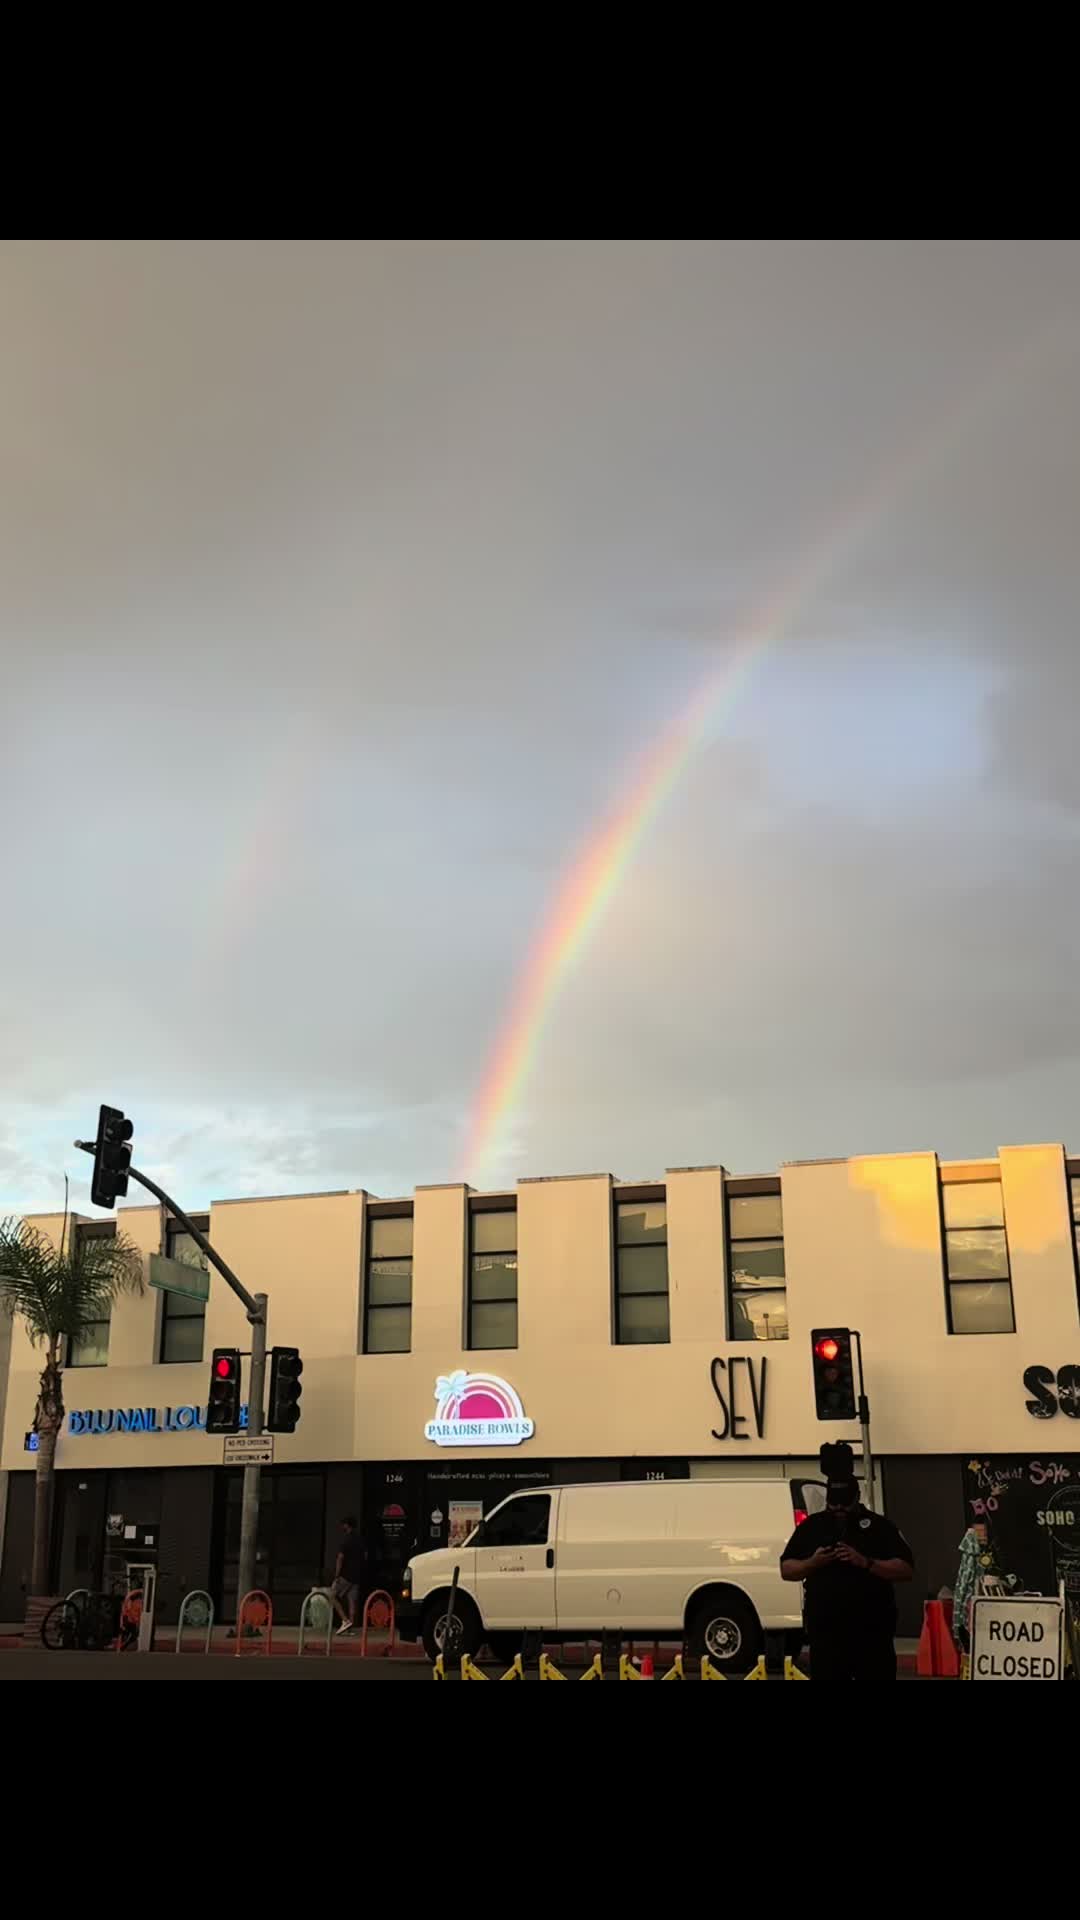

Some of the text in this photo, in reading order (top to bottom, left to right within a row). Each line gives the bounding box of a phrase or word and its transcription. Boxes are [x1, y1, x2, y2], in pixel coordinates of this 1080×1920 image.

[710, 1356, 767, 1440] SEV
[68, 1409, 114, 1434] BLU
[116, 1407, 162, 1432] NAIL
[428, 1422, 530, 1436] PARADISE BOWLS
[386, 1474, 404, 1483] 1246
[1036, 1510, 1076, 1526] SOHO
[989, 1620, 1044, 1642] ROAD
[977, 1654, 1056, 1679] CLOSED
